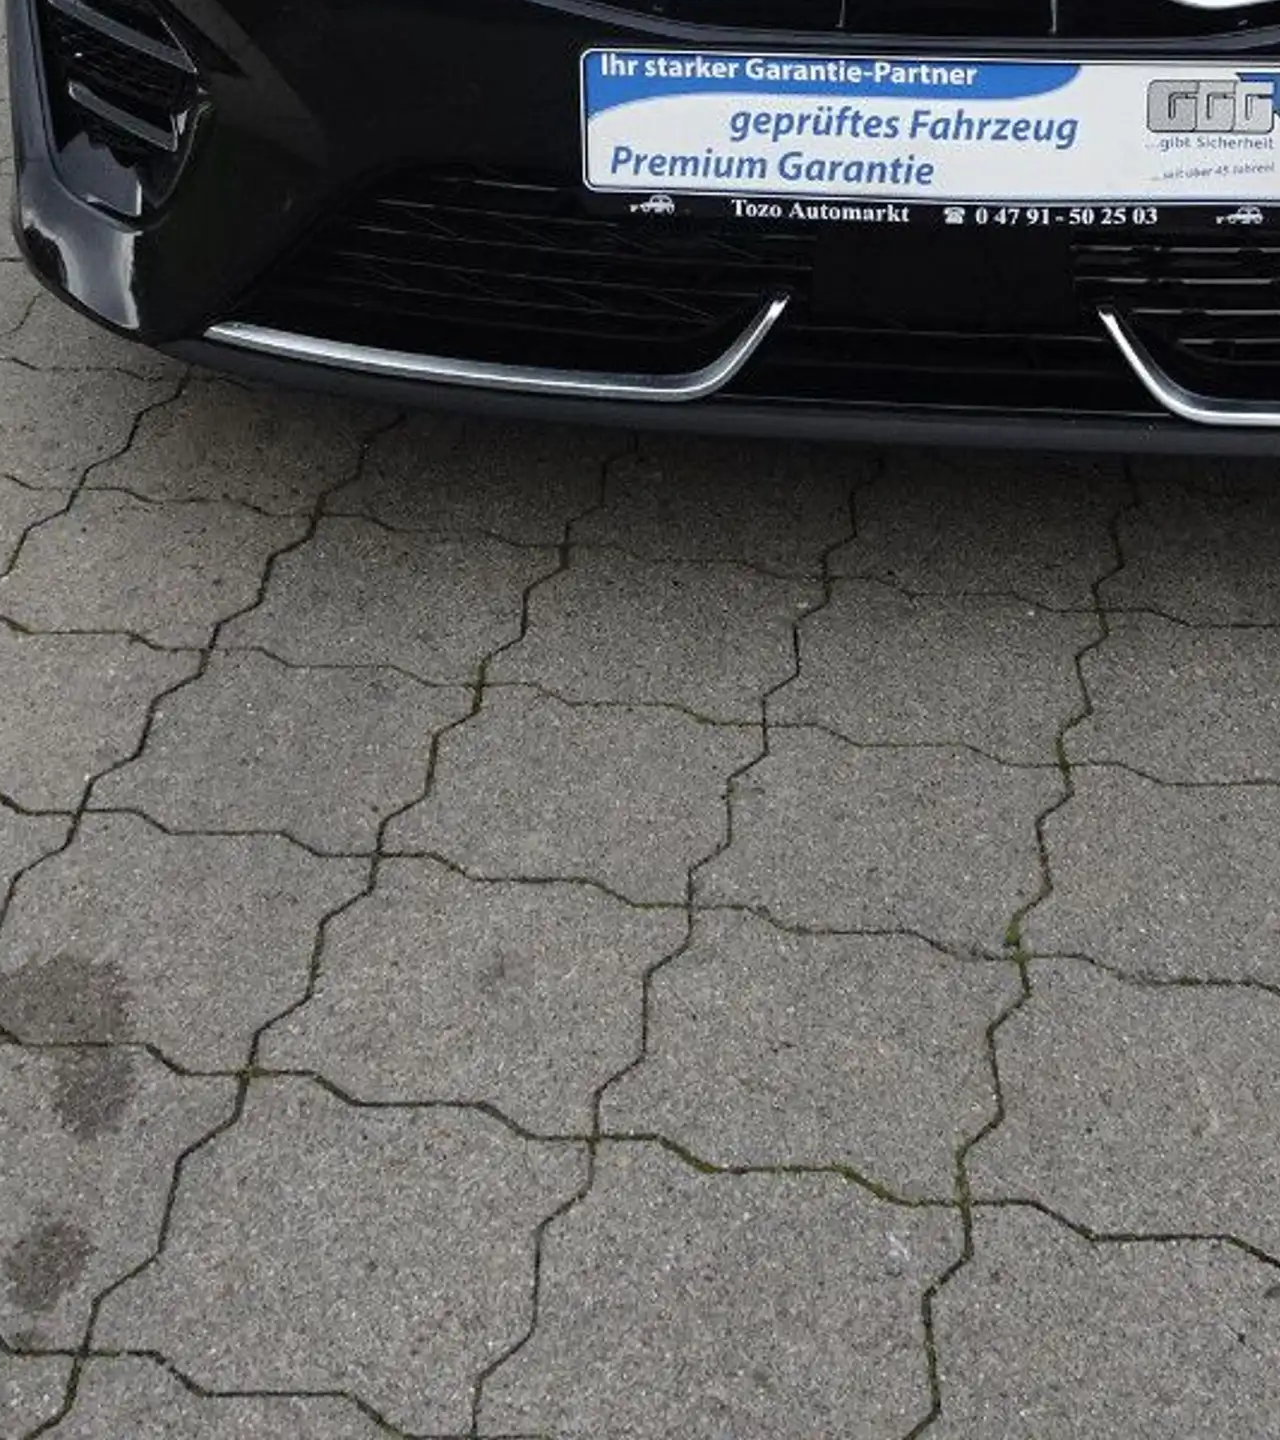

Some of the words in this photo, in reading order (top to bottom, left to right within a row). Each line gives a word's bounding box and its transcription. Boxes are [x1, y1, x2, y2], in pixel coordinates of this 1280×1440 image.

[600, 52, 639, 77] Ihr
[644, 55, 739, 81] starker
[745, 57, 978, 87] Garantie-Partner
[730, 103, 899, 144] geprüftes
[910, 110, 1079, 149] Fahrzeug
[1197, 136, 1276, 150] Sicherheit
[610, 146, 767, 180] Premium
[777, 151, 934, 185] Garantie
[732, 198, 784, 220] Tozo
[788, 201, 910, 224] Automarkt
[1131, 206, 1158, 224] 03
